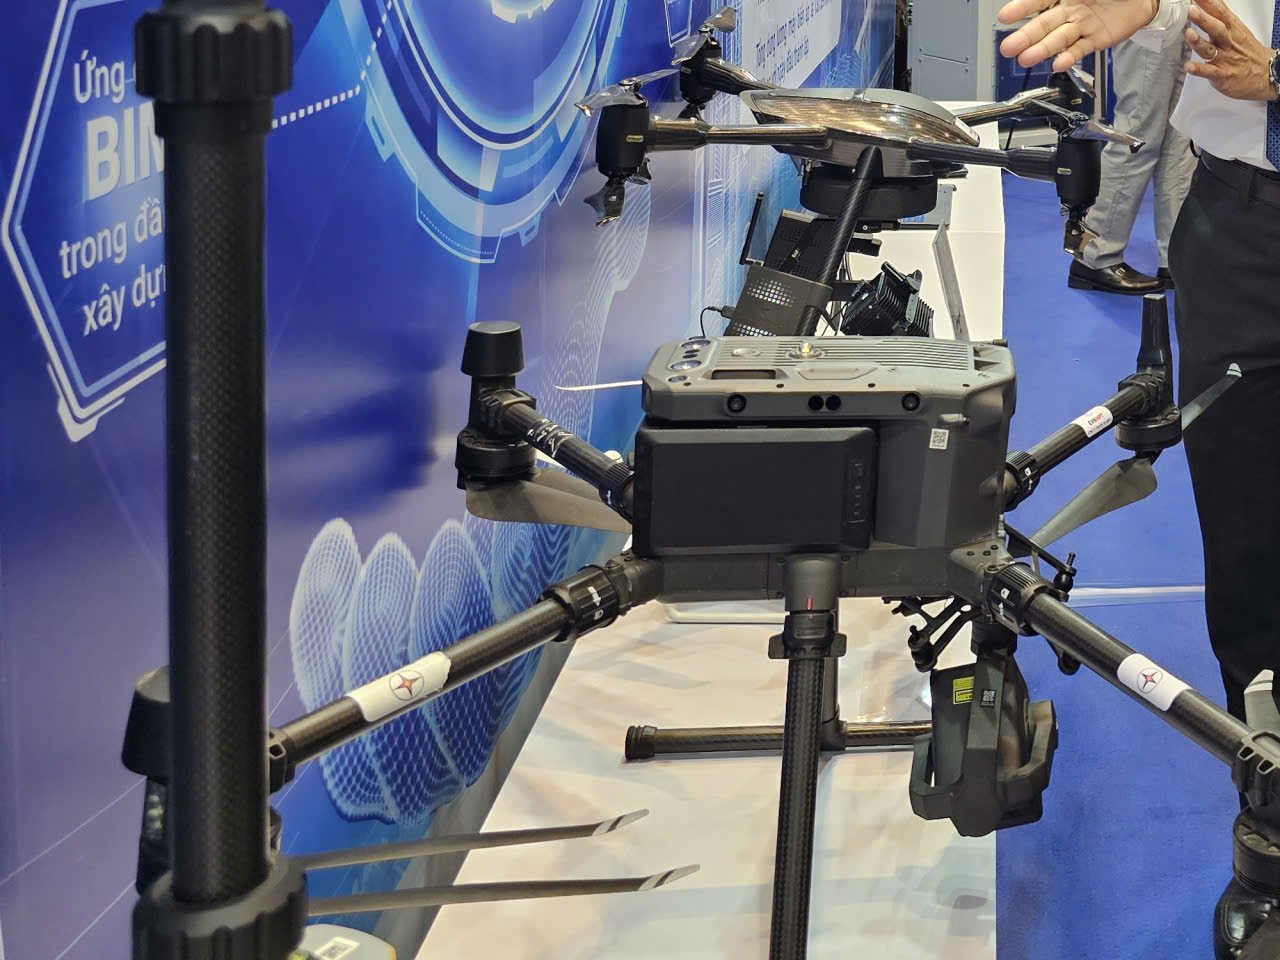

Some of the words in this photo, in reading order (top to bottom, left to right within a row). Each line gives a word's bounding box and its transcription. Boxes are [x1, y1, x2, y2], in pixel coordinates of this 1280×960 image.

[72, 49, 128, 105] Ứng
[133, 198, 164, 243] đầ
[59, 220, 128, 280] trong
[82, 285, 127, 337] xây
[132, 262, 167, 310] dự
